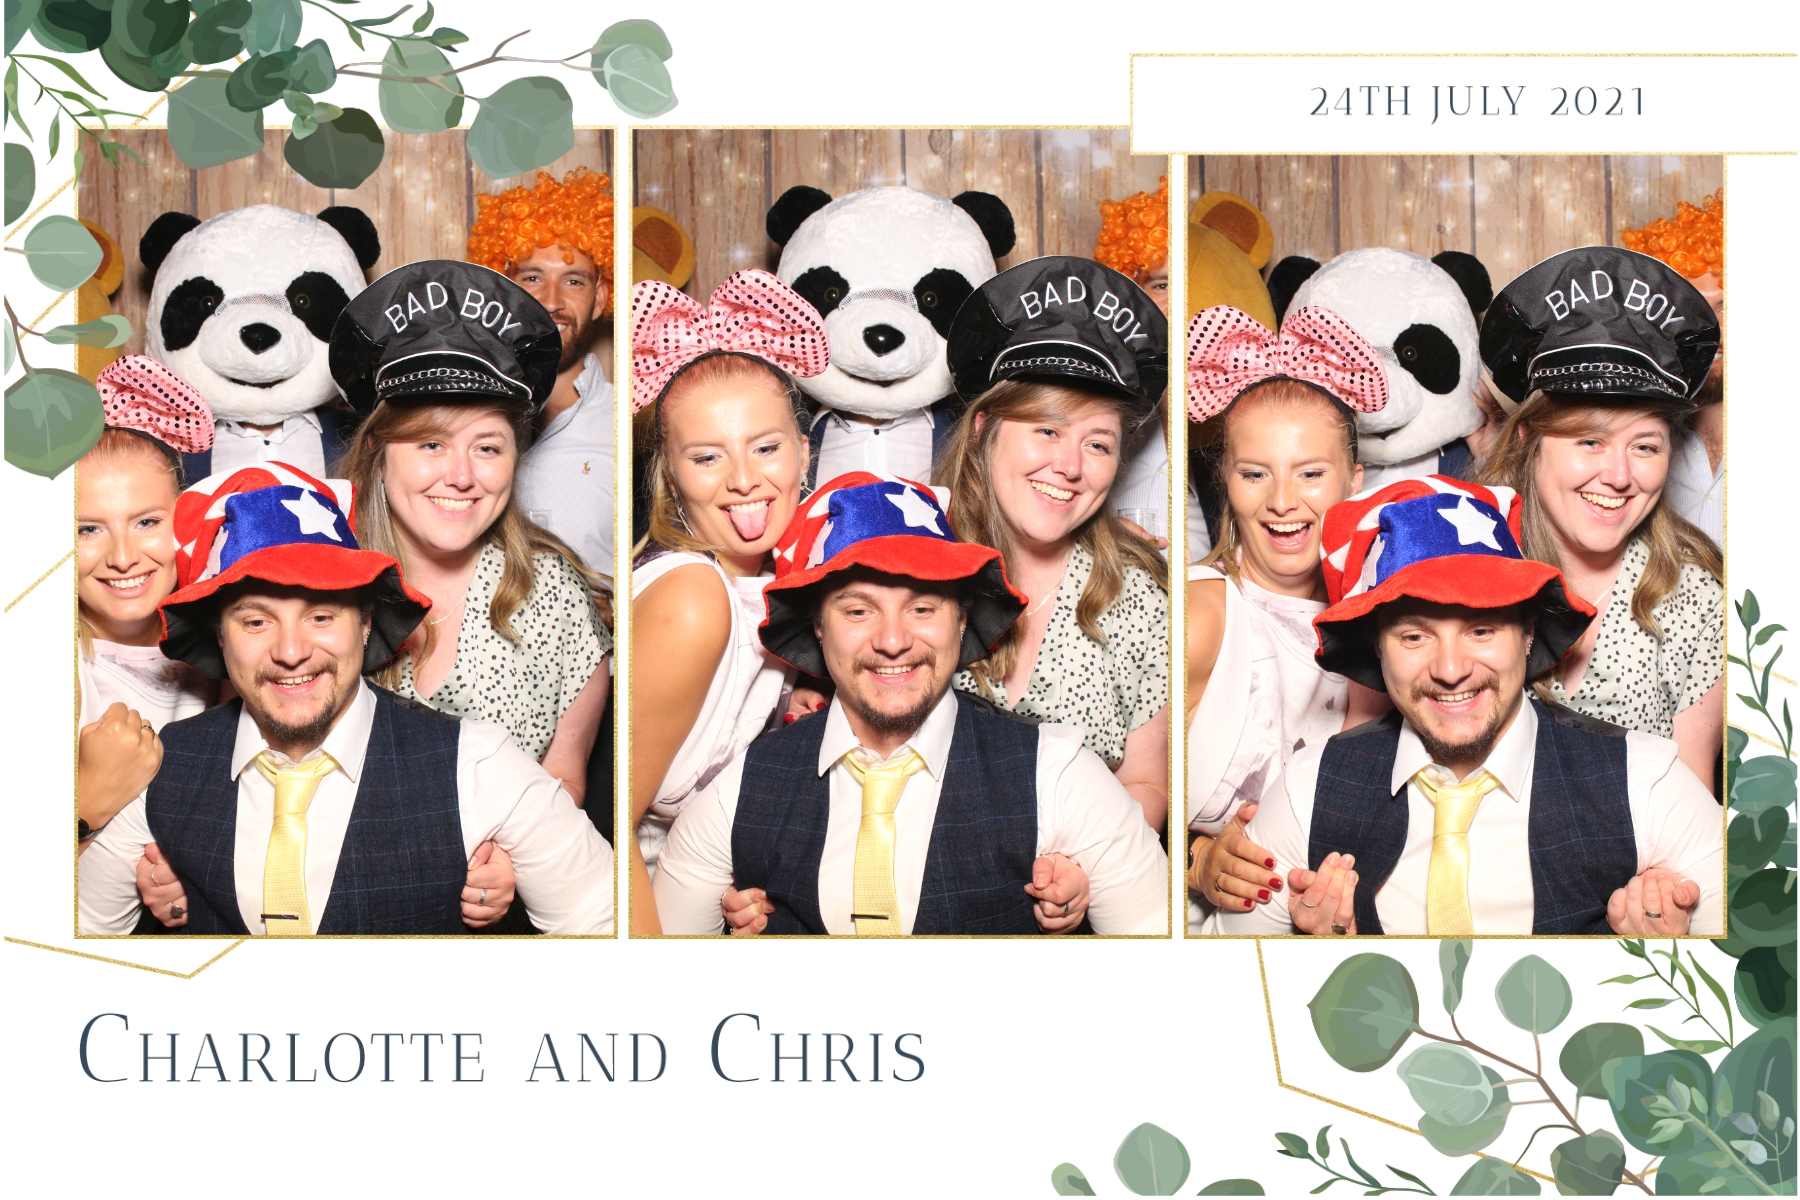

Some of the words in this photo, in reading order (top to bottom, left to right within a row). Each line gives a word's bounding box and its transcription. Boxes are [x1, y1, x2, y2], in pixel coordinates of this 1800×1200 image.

[384, 281, 448, 333] BAD
[460, 288, 522, 337] BOY
[1020, 276, 1087, 319] BAD
[1093, 290, 1148, 345] BOY
[1545, 269, 1614, 321] BAD
[1624, 278, 1686, 331] BOY
